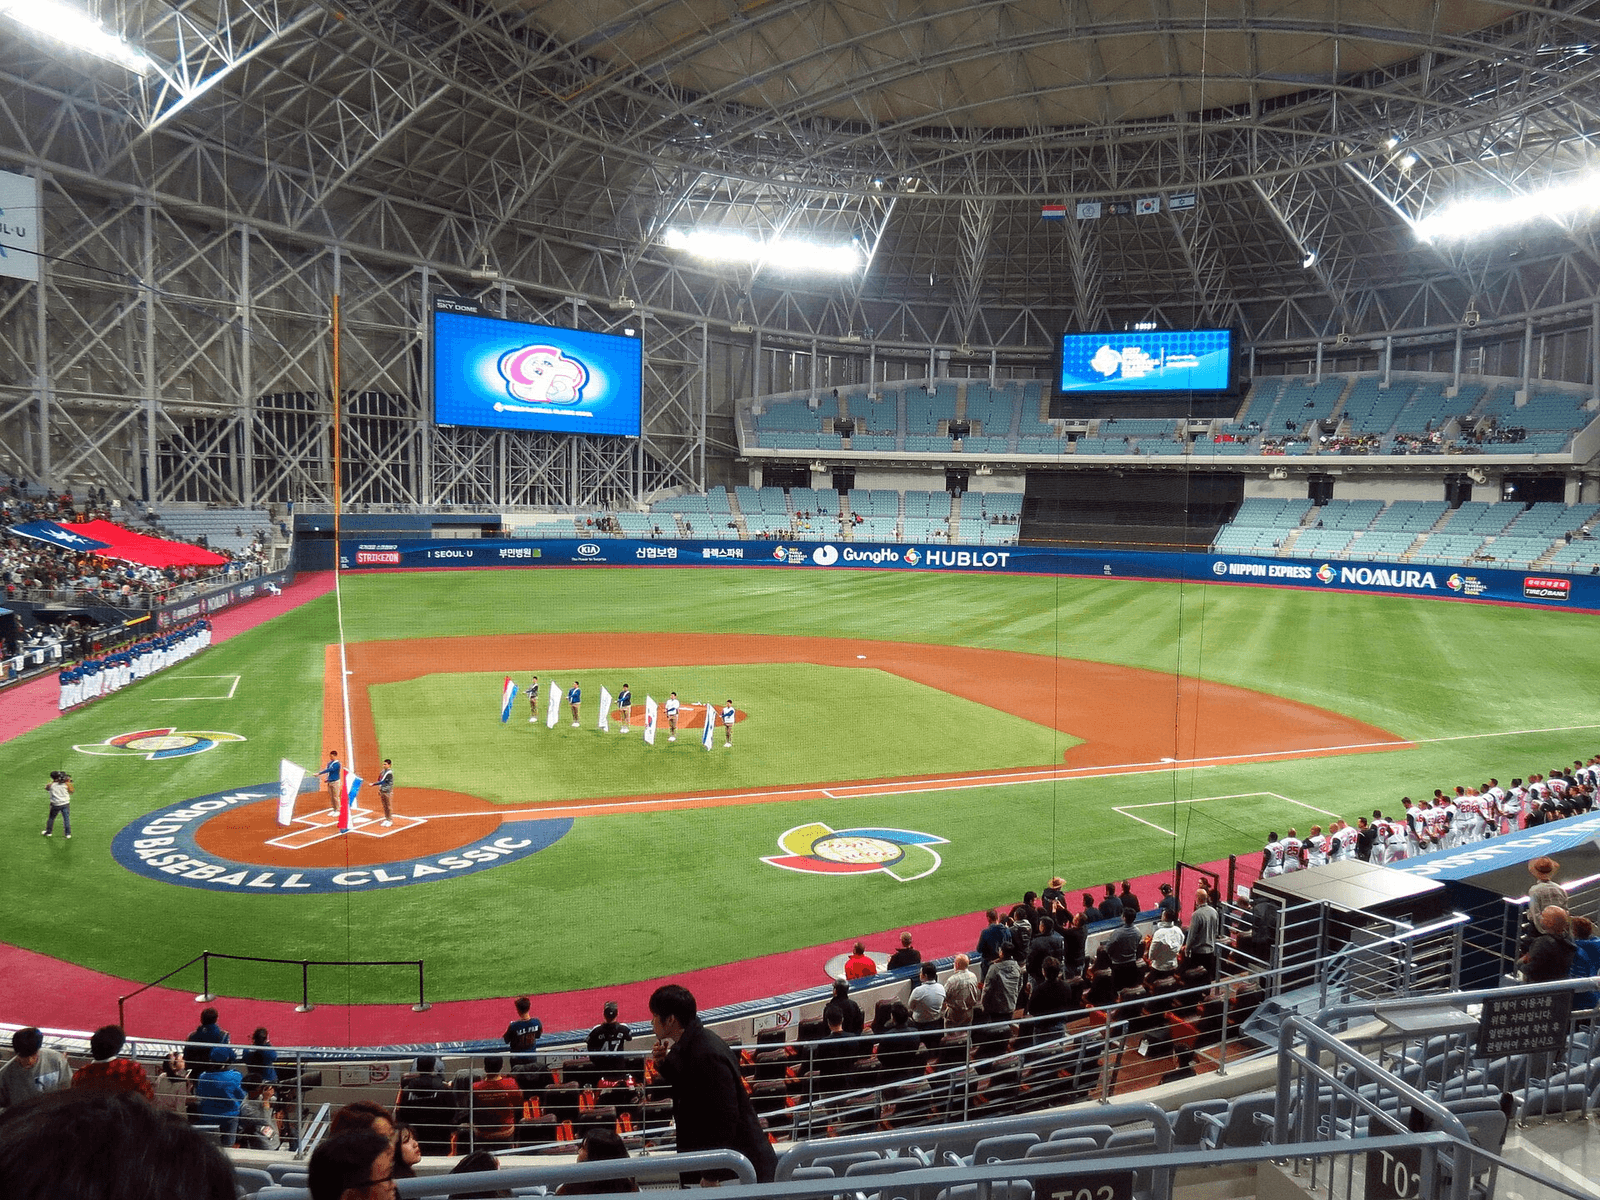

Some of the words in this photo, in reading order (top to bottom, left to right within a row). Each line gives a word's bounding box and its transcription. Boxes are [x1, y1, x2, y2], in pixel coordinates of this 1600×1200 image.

[437, 302, 454, 310] SKY
[454, 304, 478, 313] DOME
[499, 548, 532, 558] 부민병원
[581, 546, 597, 554] KIA
[635, 547, 678, 558] 신협보험
[843, 548, 899, 564] GungHo
[926, 550, 1010, 567] HUBLOT
[1229, 563, 1266, 577] NIPPON
[1268, 565, 1312, 579] EXPRESS
[1340, 567, 1437, 589] NOMURA
[141, 792, 267, 835] WORLD
[133, 836, 311, 888] BASEBALL
[332, 836, 532, 886] CLASSIC
